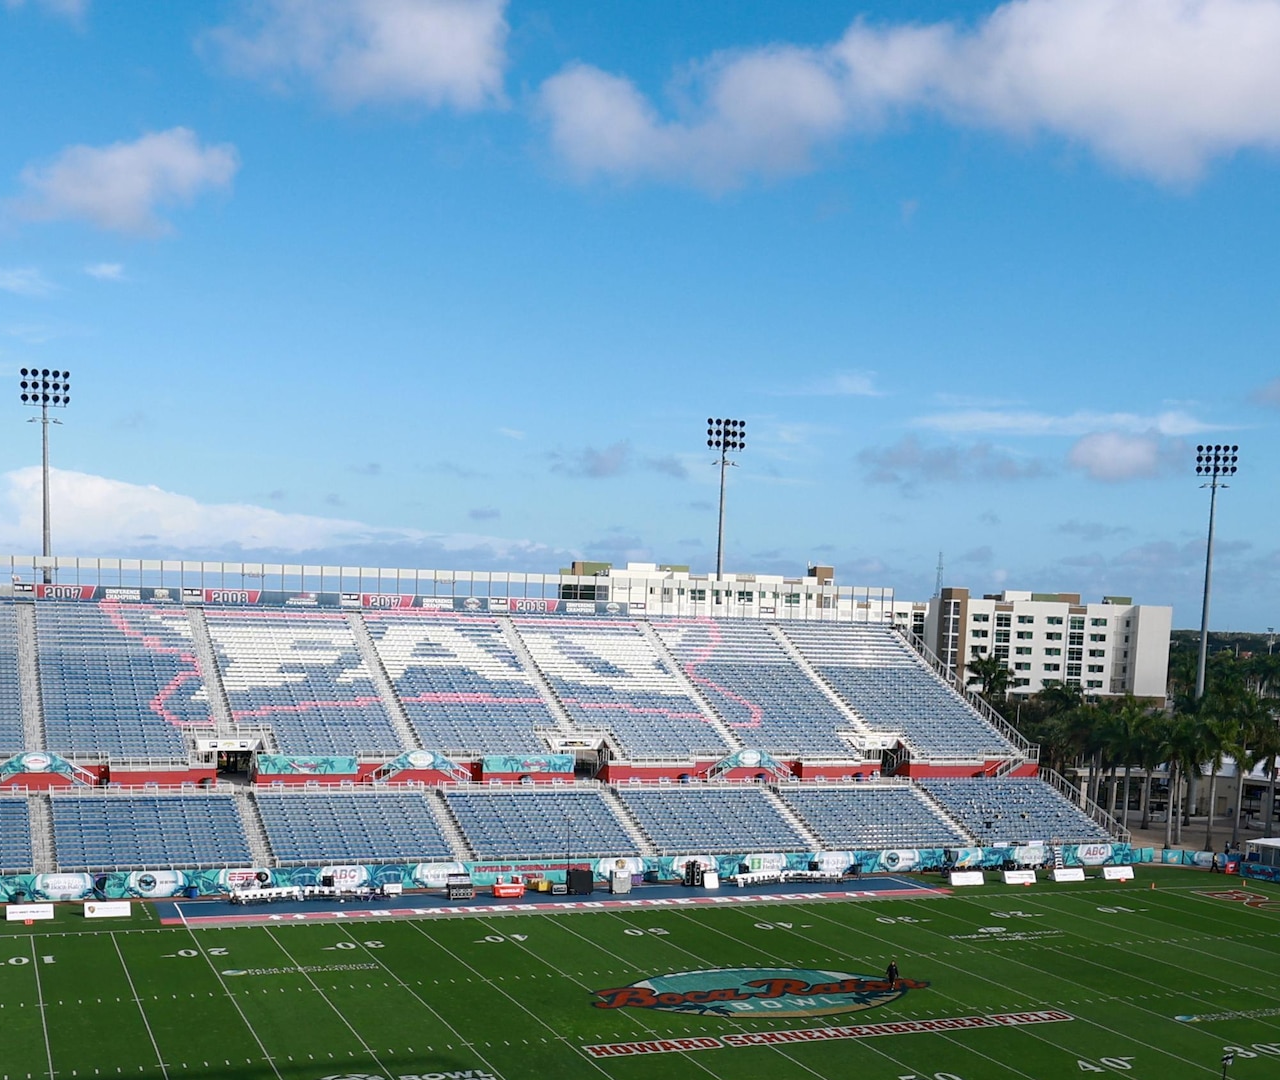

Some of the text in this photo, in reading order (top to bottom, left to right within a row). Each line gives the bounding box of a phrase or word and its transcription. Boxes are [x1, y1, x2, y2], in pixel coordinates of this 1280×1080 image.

[45, 586, 82, 599] 2007
[211, 591, 248, 602] 2008
[370, 595, 401, 607] 2017
[517, 600, 546, 611] 2019
[175, 619, 690, 700] FAU
[1084, 846, 1105, 856] ABC
[331, 869, 357, 879] ABC
[592, 977, 928, 1008] Boca Raton
[731, 996, 846, 1012] BOWL
[586, 1010, 1073, 1057] HOWARD SCHNELLENBERGER FIELD
[1077, 1057, 1133, 1075] 40
